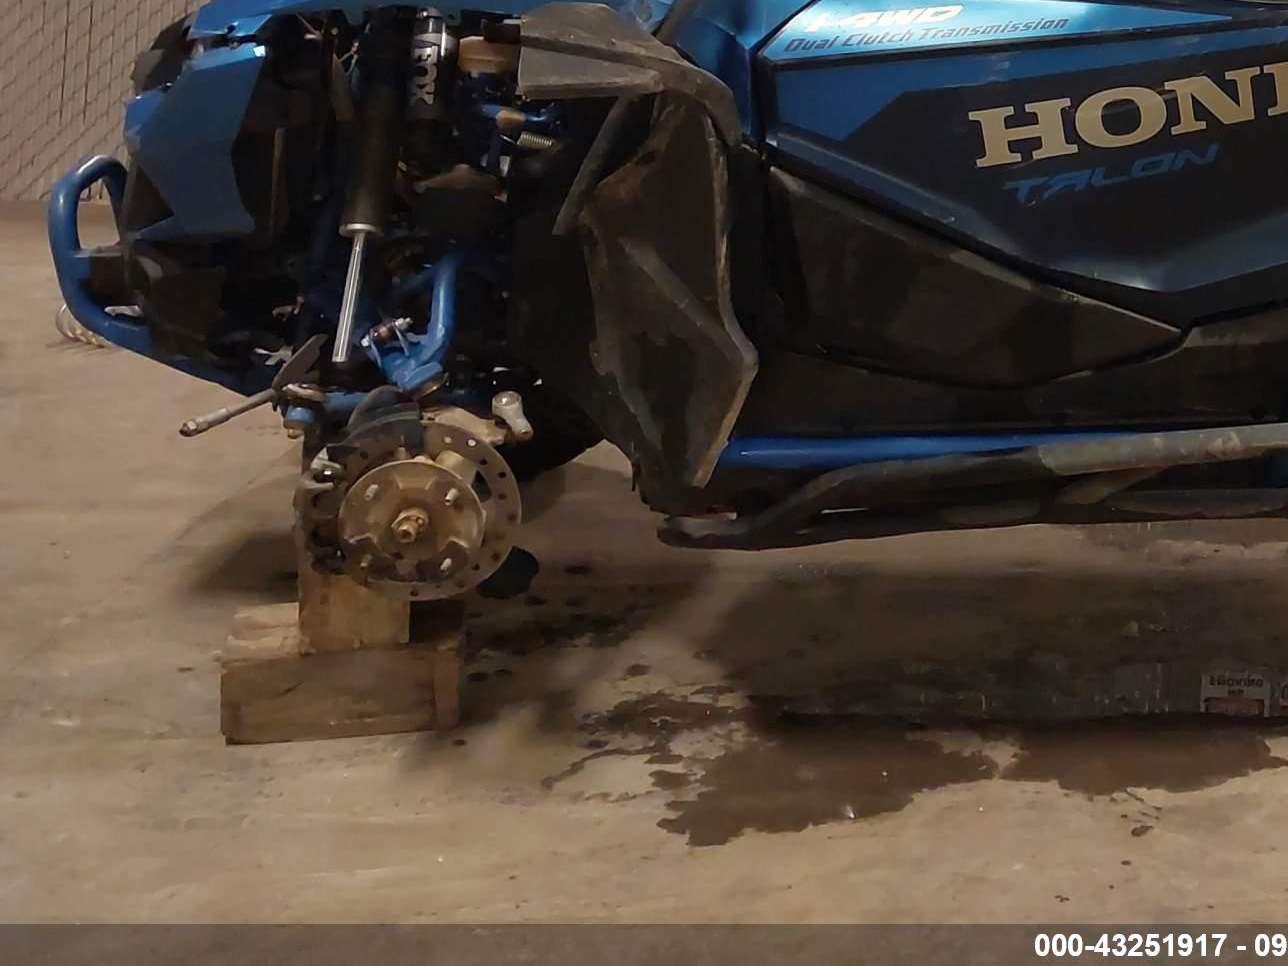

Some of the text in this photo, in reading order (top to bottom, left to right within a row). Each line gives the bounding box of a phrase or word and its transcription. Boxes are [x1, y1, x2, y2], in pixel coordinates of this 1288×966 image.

[784, 18, 1070, 52] Dual Clutch Transmission
[414, 44, 438, 105] FOX
[1004, 143, 1220, 205] TALON
